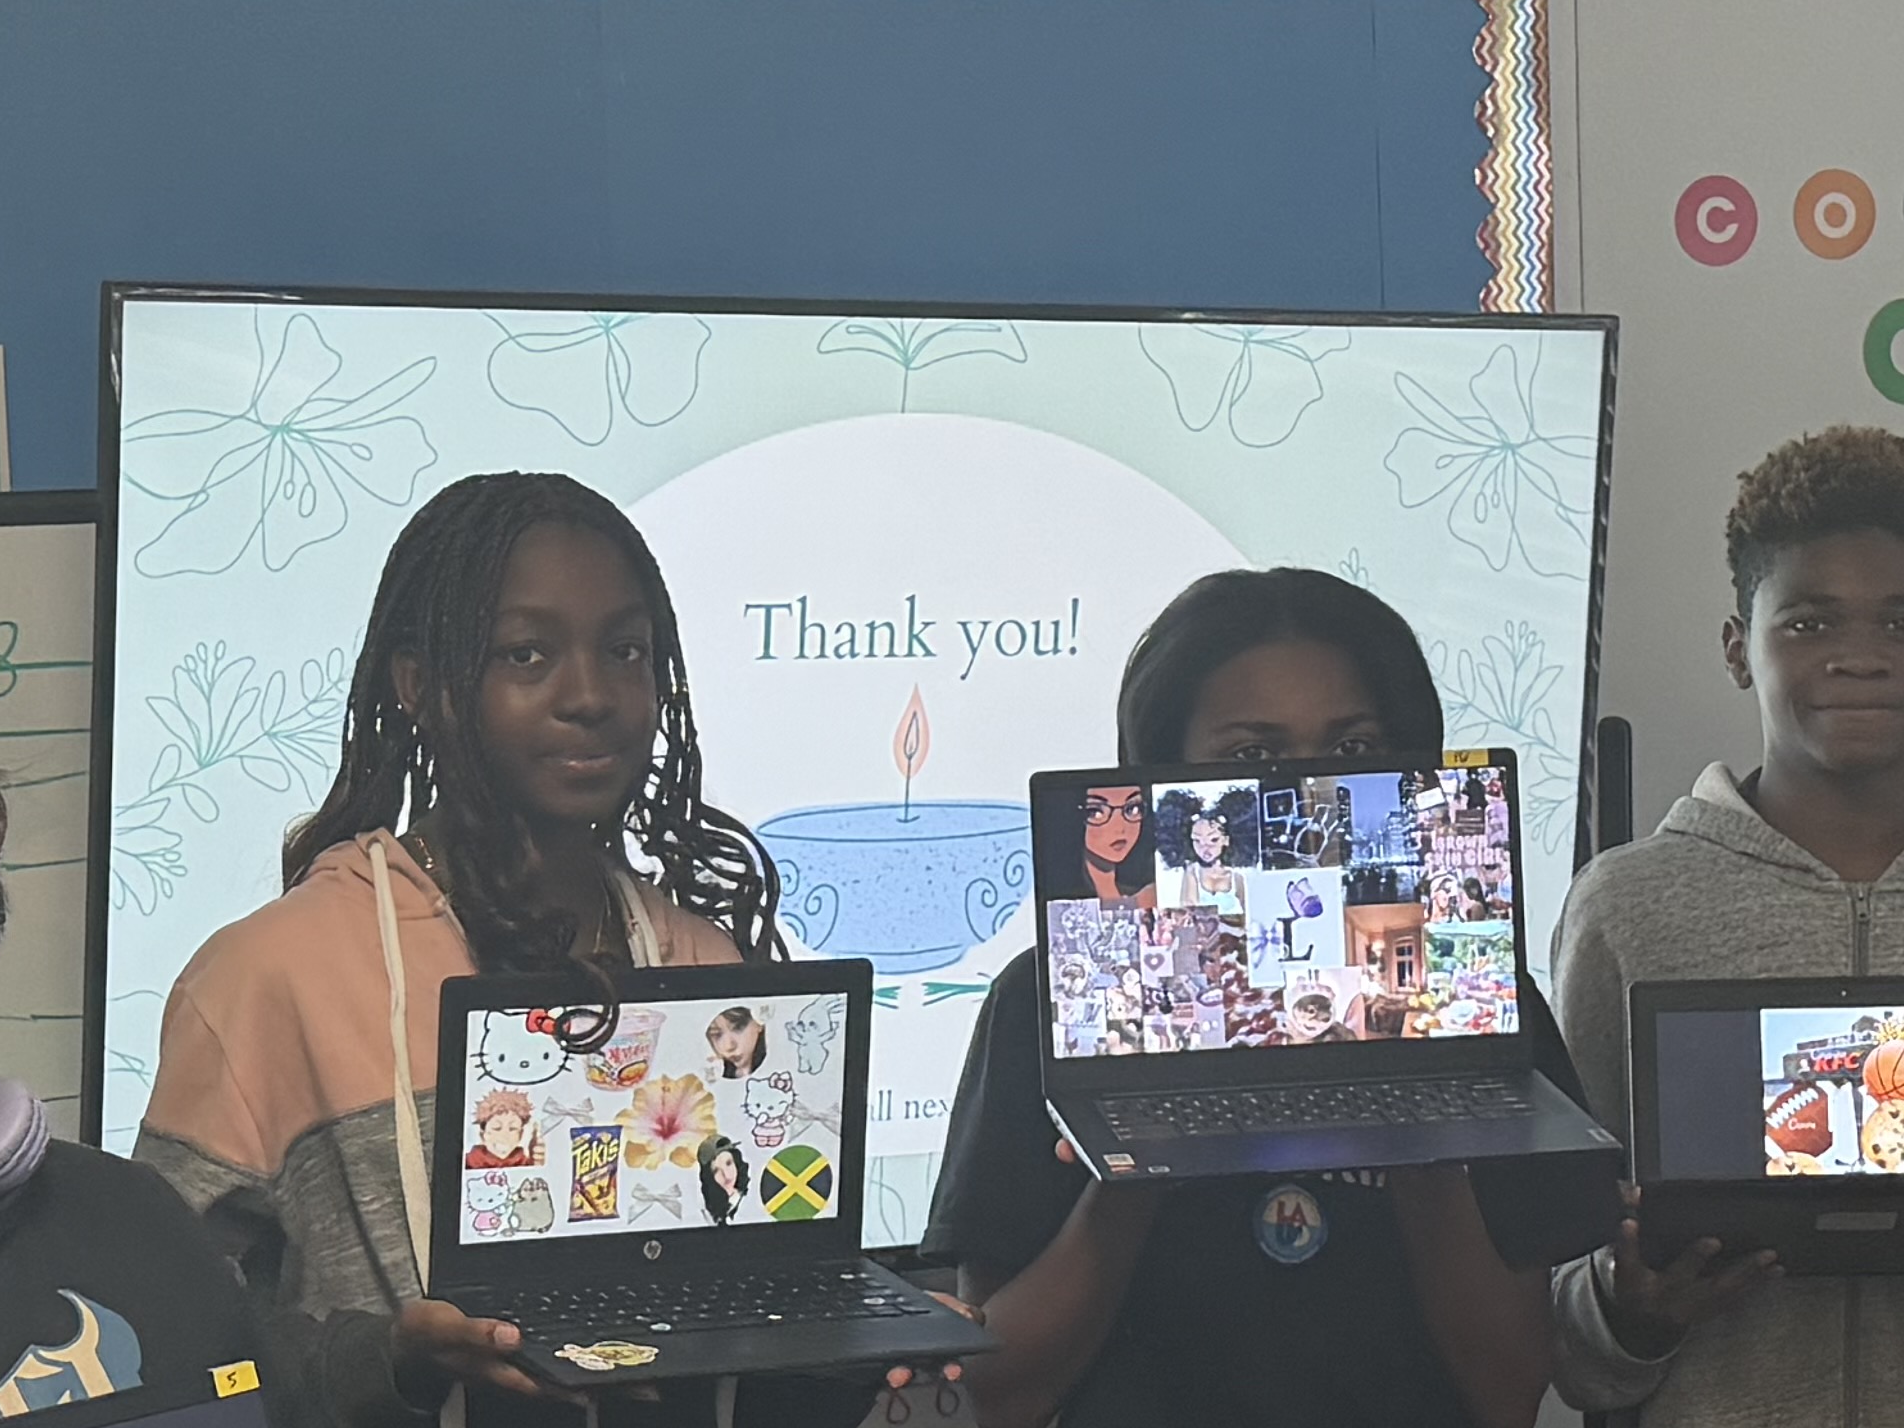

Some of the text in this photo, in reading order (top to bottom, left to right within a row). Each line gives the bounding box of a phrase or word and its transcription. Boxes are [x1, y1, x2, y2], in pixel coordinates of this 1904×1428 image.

[743, 595, 1082, 682] Thank you!
[1276, 917, 1314, 961] L
[1813, 1051, 1861, 1072] KFC
[904, 1098, 949, 1120] nex
